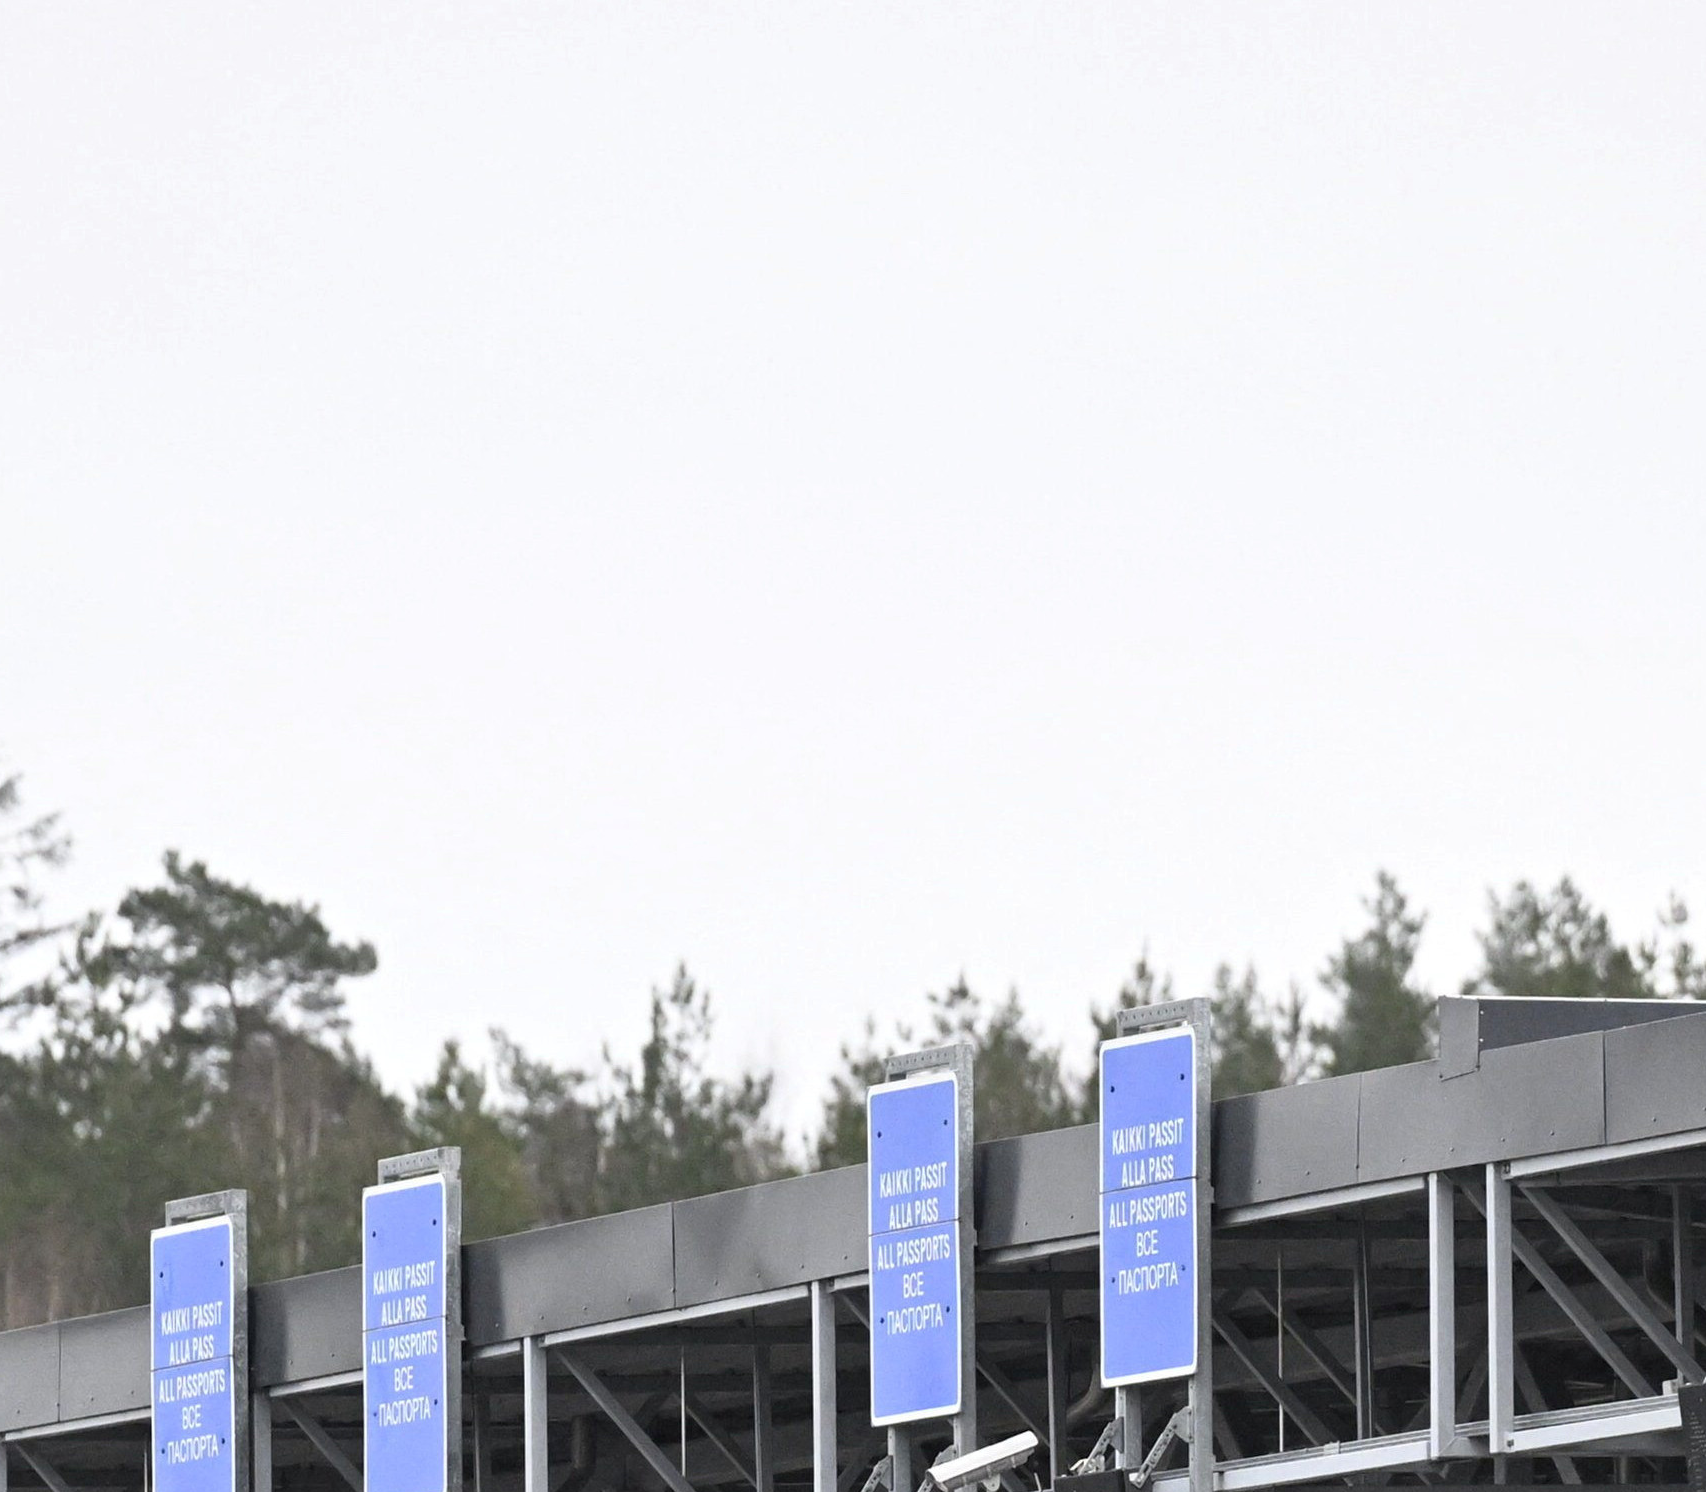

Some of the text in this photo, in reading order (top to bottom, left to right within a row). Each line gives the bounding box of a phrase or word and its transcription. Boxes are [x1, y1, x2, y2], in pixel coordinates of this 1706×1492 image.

[1112, 1118, 1184, 1156] KAIKKI PASSIT
[879, 1161, 948, 1198] KAIKKI PASSIT
[1121, 1154, 1174, 1188] ALLA PASS
[888, 1197, 939, 1230] ALLA PASS
[1109, 1191, 1187, 1229] ALL PASSPORTS
[877, 1233, 950, 1271] ALL PASSPORTS
[1136, 1229, 1159, 1258] ВСЕ
[373, 1260, 436, 1295] KAIKKI PASSIT
[902, 1272, 925, 1298] ВСЕ
[1118, 1261, 1179, 1296] ПАСПОРТА
[161, 1301, 223, 1336] KAIKKI PASSIT
[380, 1294, 427, 1326] ALLA PASS
[886, 1303, 943, 1335] ПАСПОРТА
[169, 1335, 214, 1366] ALLA PASS
[370, 1329, 438, 1365] ALL PASSPORTS
[158, 1368, 226, 1404] ALL PASSPORTS
[394, 1366, 414, 1392] ВСЕ
[181, 1404, 202, 1430] ВСЕ
[378, 1395, 431, 1427] ПАСПОРТА
[167, 1434, 219, 1464] ПАСПОРТА
